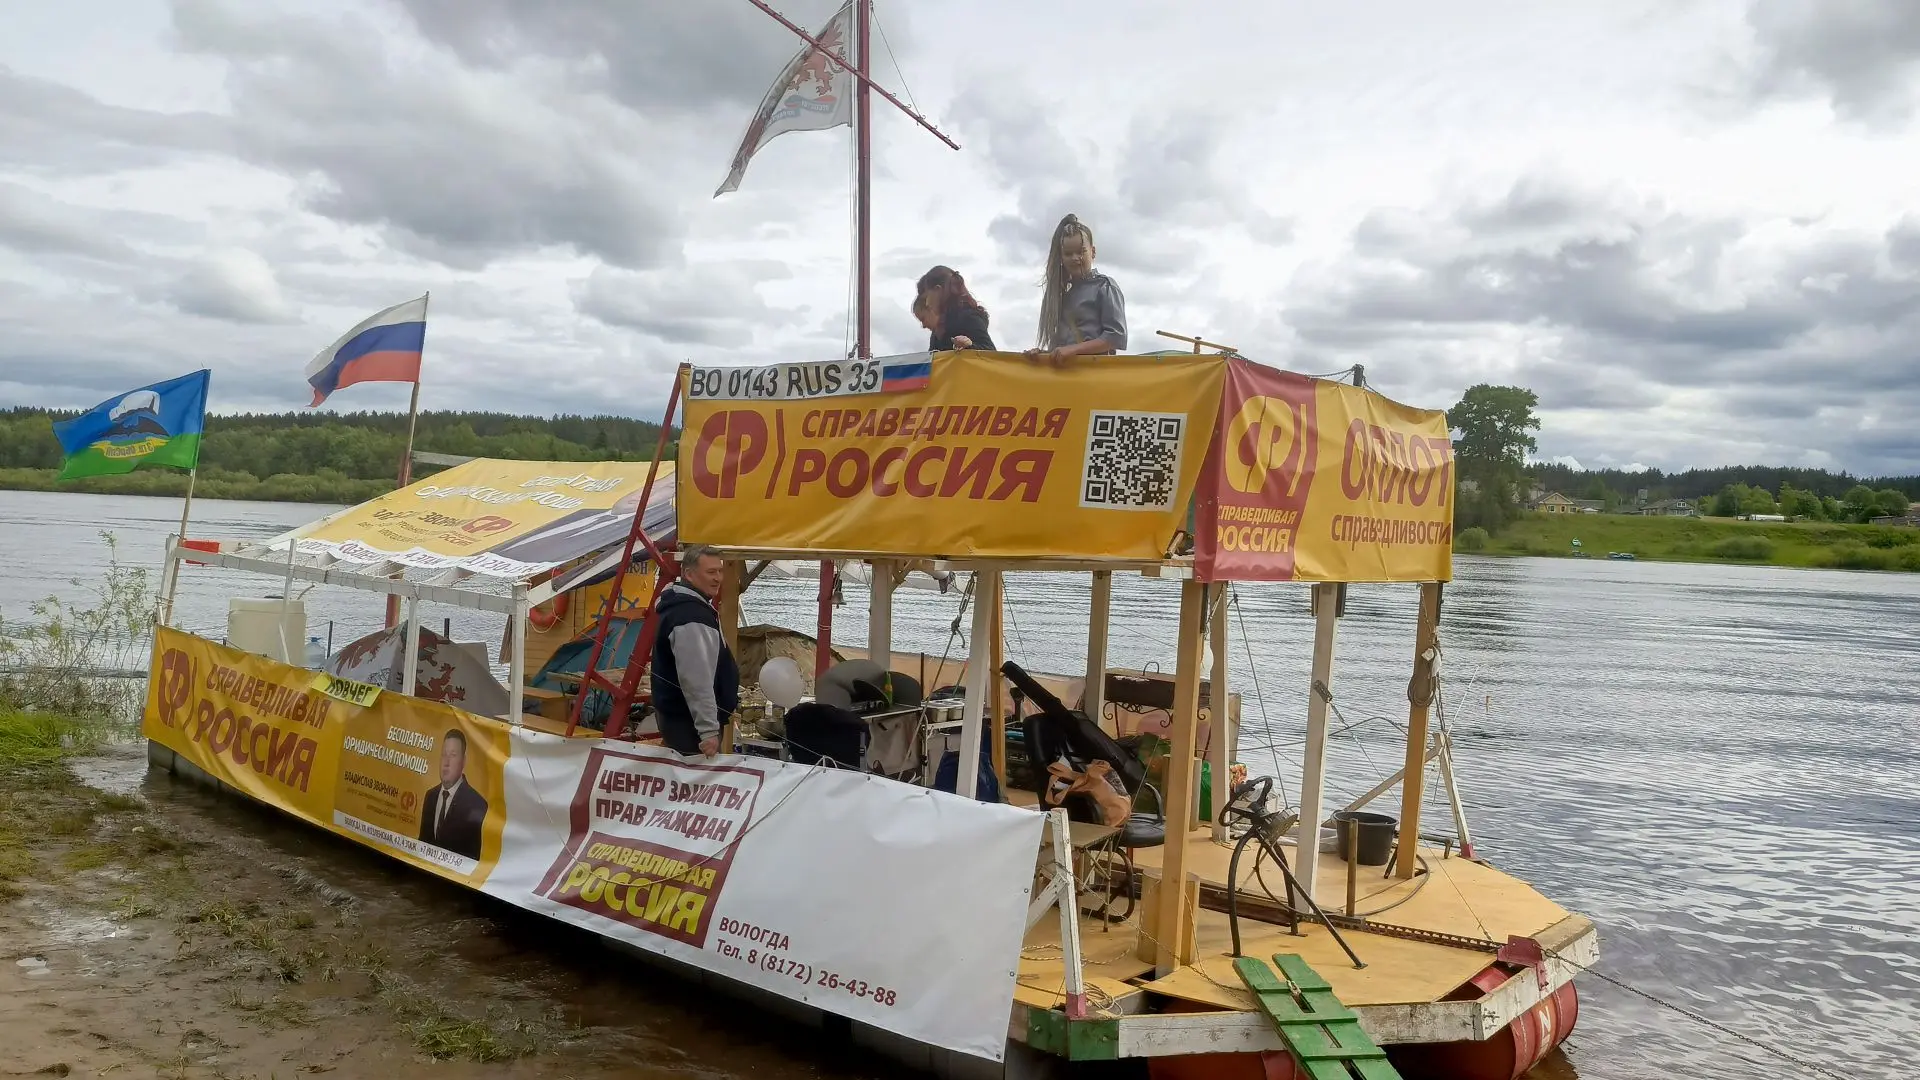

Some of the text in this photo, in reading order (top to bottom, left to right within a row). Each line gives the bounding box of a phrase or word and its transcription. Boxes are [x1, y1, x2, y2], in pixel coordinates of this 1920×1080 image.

[729, 367, 778, 397] 0143
[786, 363, 842, 397] RUS
[848, 360, 881, 392] 35
[802, 405, 1071, 440] СПРАВЕДЛИВАЯ
[788, 446, 1054, 503] РОССИЯ
[1341, 418, 1453, 507] ОПЛОТ
[206, 663, 332, 730] СПРАВЕДЛИВАЯ
[192, 698, 319, 793] РОССИЯ
[343, 735, 429, 775] ЮРИДИЧЕСКАЯ ПОМОЩЬ
[386, 725, 434, 751] БЕСПЛАТНАЯ
[598, 769, 666, 797] ЦЕНТР
[595, 798, 733, 842] ПРАВ ГРАЖДАН
[586, 842, 716, 890] СПРАВЕДЛИВАЯ
[558, 861, 707, 935] РОССИЯ
[719, 916, 790, 951] ВОЛОГДА
[716, 938, 897, 1007] Тел. 8 (8172) 26-43-88
